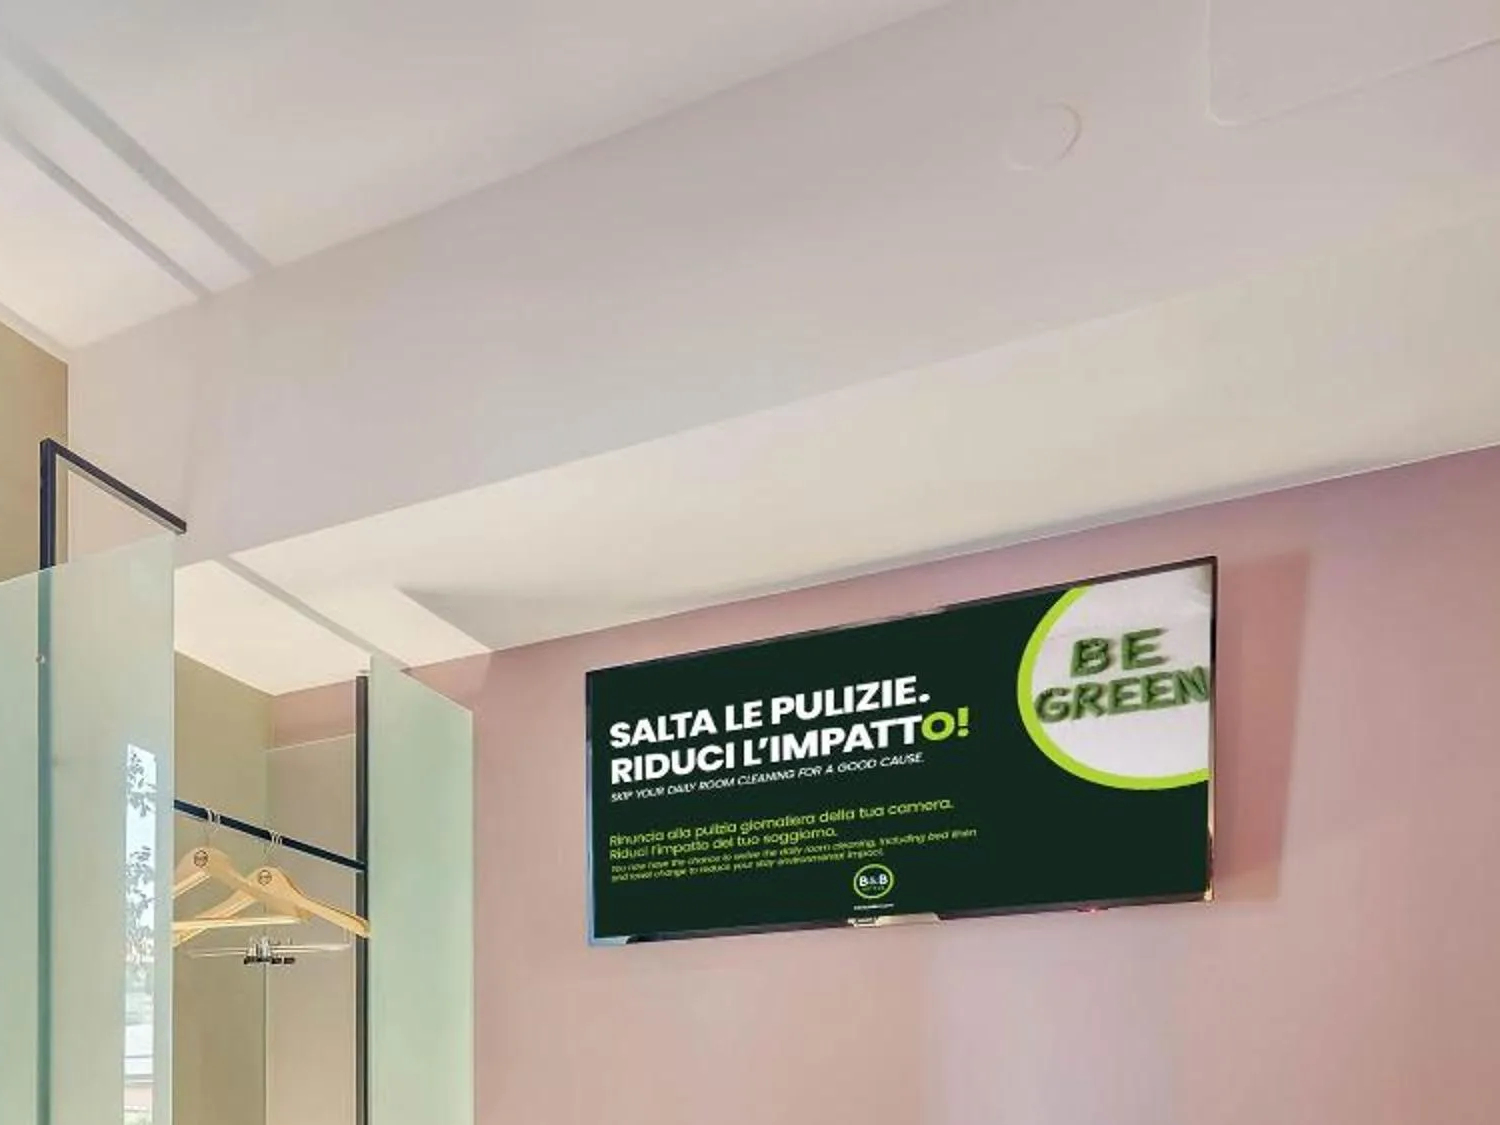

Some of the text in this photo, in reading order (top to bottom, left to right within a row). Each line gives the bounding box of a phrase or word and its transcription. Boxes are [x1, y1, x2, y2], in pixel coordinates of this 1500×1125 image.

[1070, 627, 1169, 678] BE
[609, 675, 930, 748] SALTA LE PULIZIE.
[1035, 666, 1209, 723] GREEN
[611, 742, 735, 784] RIDUCI
[611, 752, 925, 803] SKIP YOUR DAILY ROOM CLEANING FOR A GOOD CAUSE.
[609, 799, 954, 847] Rinuncia alla pulizia giornaliera della tua camera.
[609, 846, 648, 860] Riduci
[712, 835, 734, 849] del
[737, 834, 760, 846] tuo
[763, 827, 838, 845] soggiorno.
[859, 873, 888, 887] B&B
